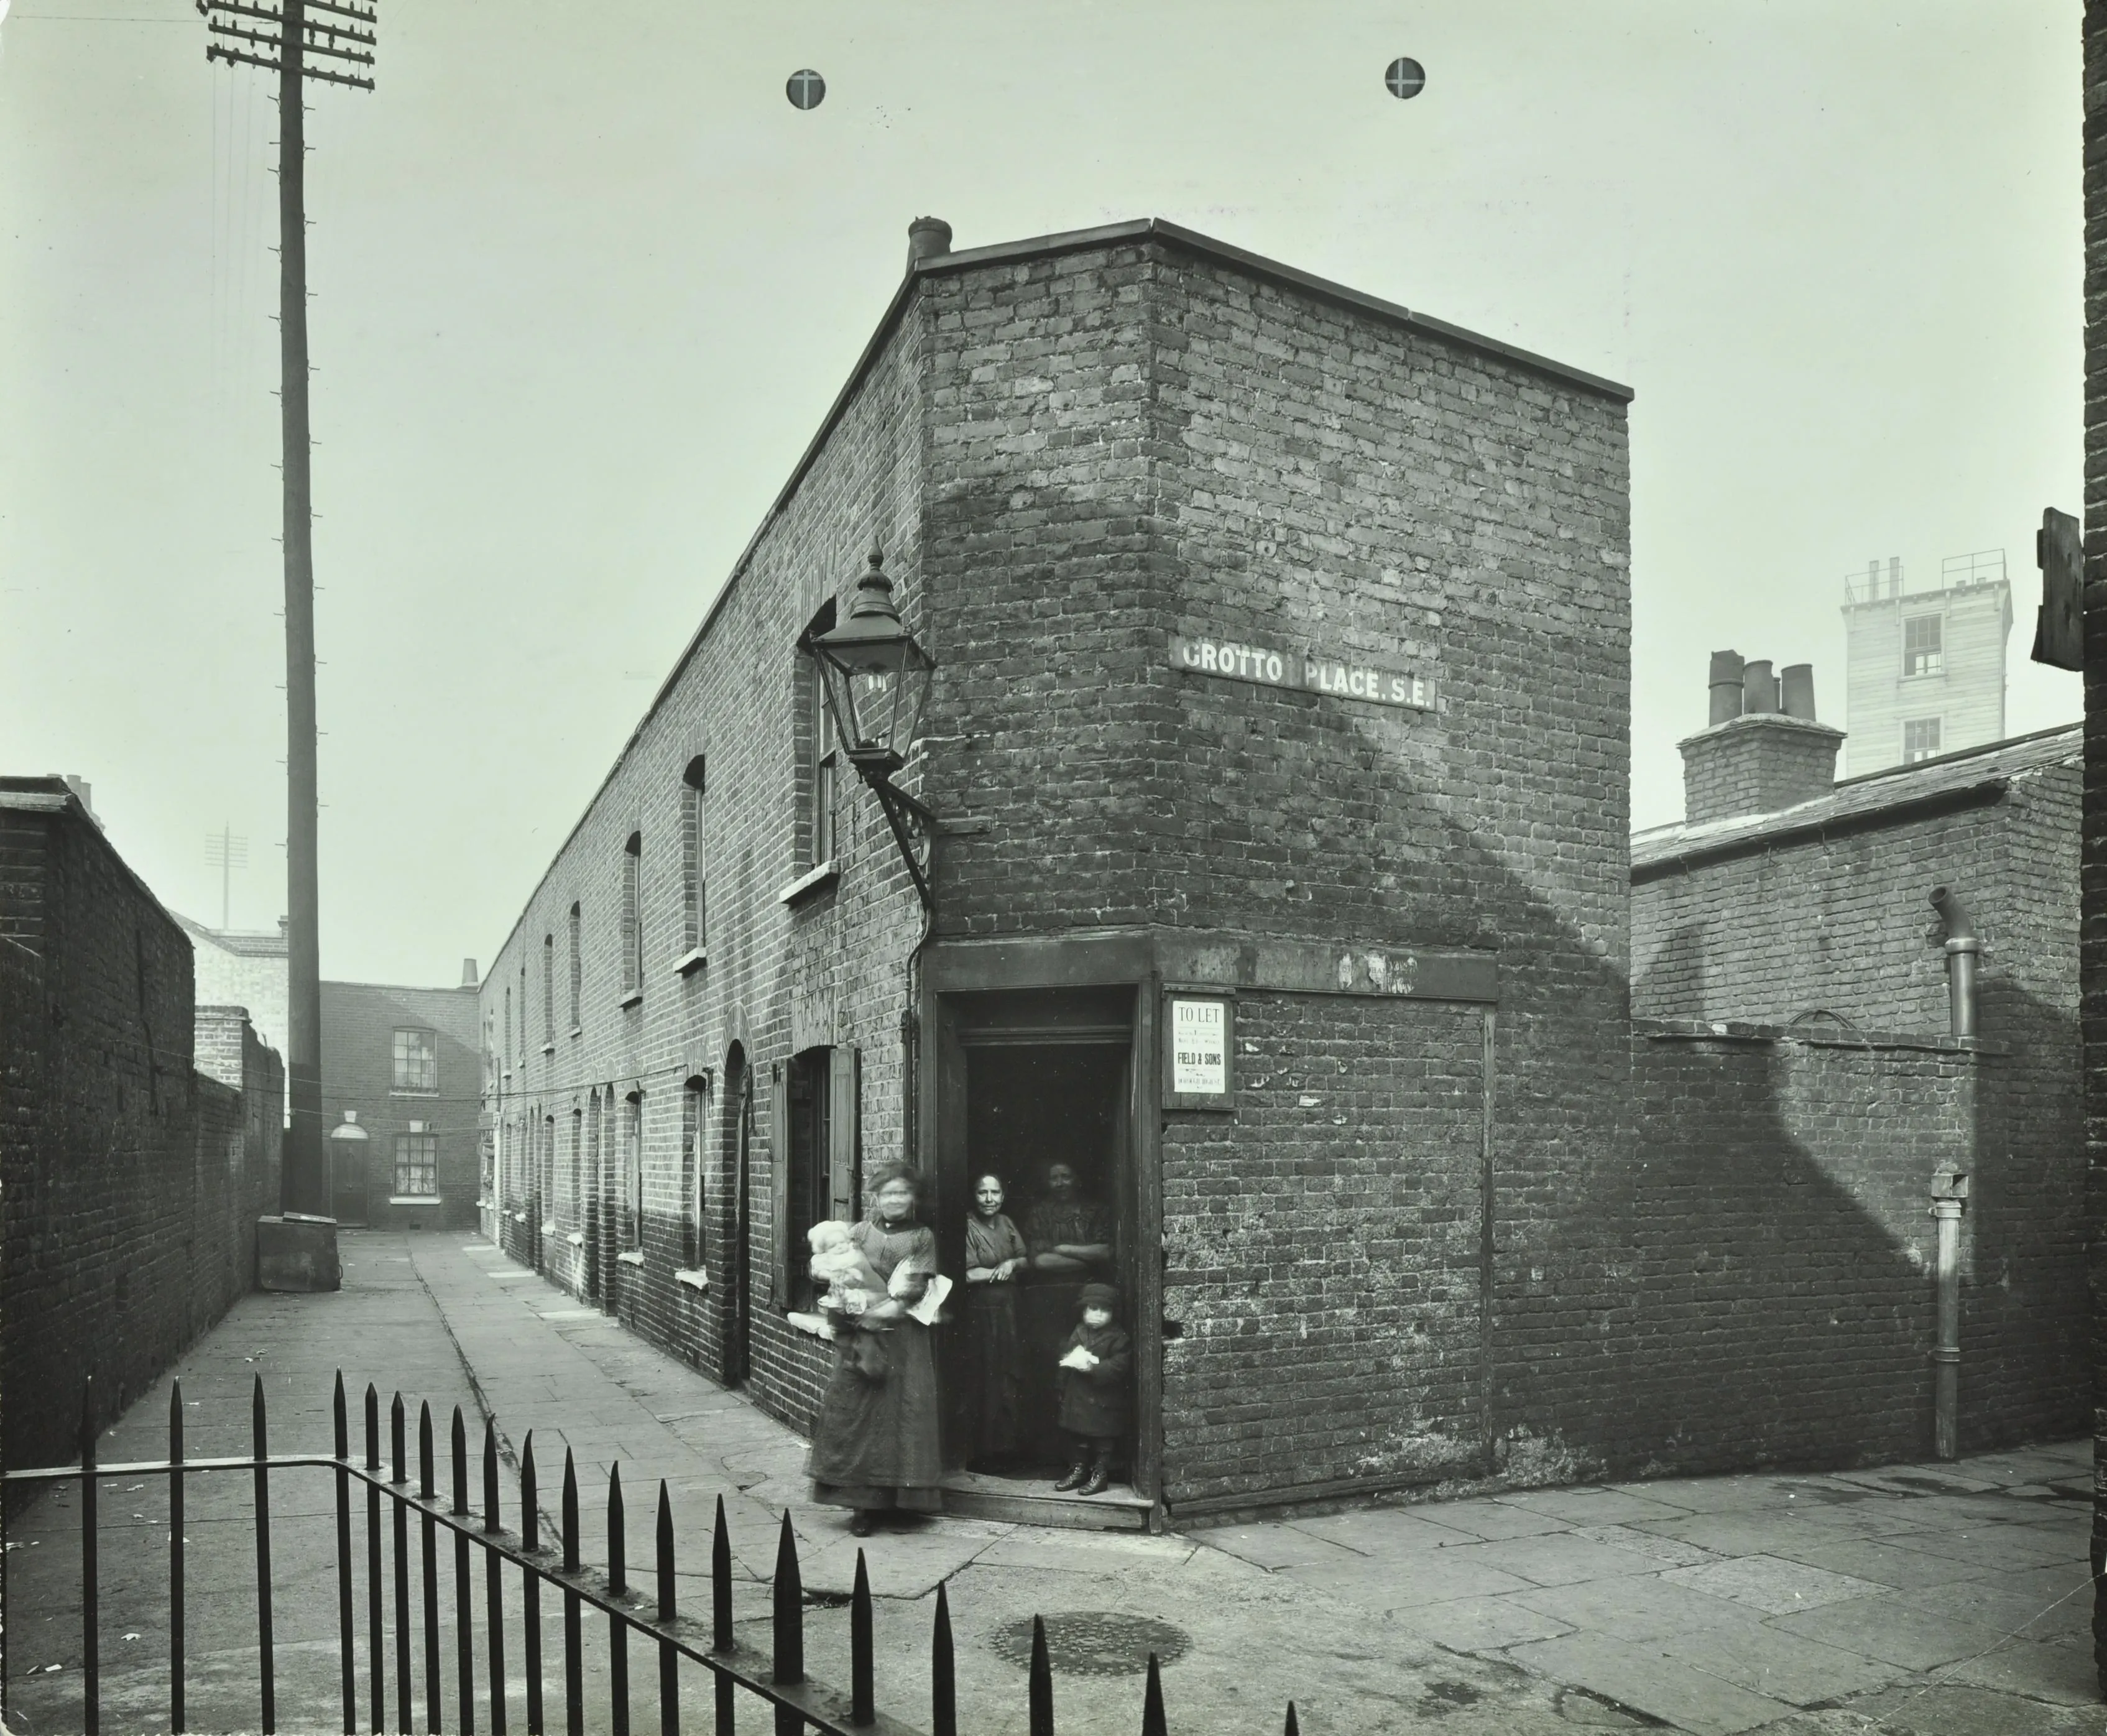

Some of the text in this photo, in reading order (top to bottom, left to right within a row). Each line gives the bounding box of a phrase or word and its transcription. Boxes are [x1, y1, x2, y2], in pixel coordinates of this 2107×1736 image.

[1183, 642, 1283, 681] GROTTO
[1391, 678, 1431, 707] S.E.
[1178, 1007, 1220, 1023] TO LET
[1178, 1052, 1222, 1066] FIELD & SONS
